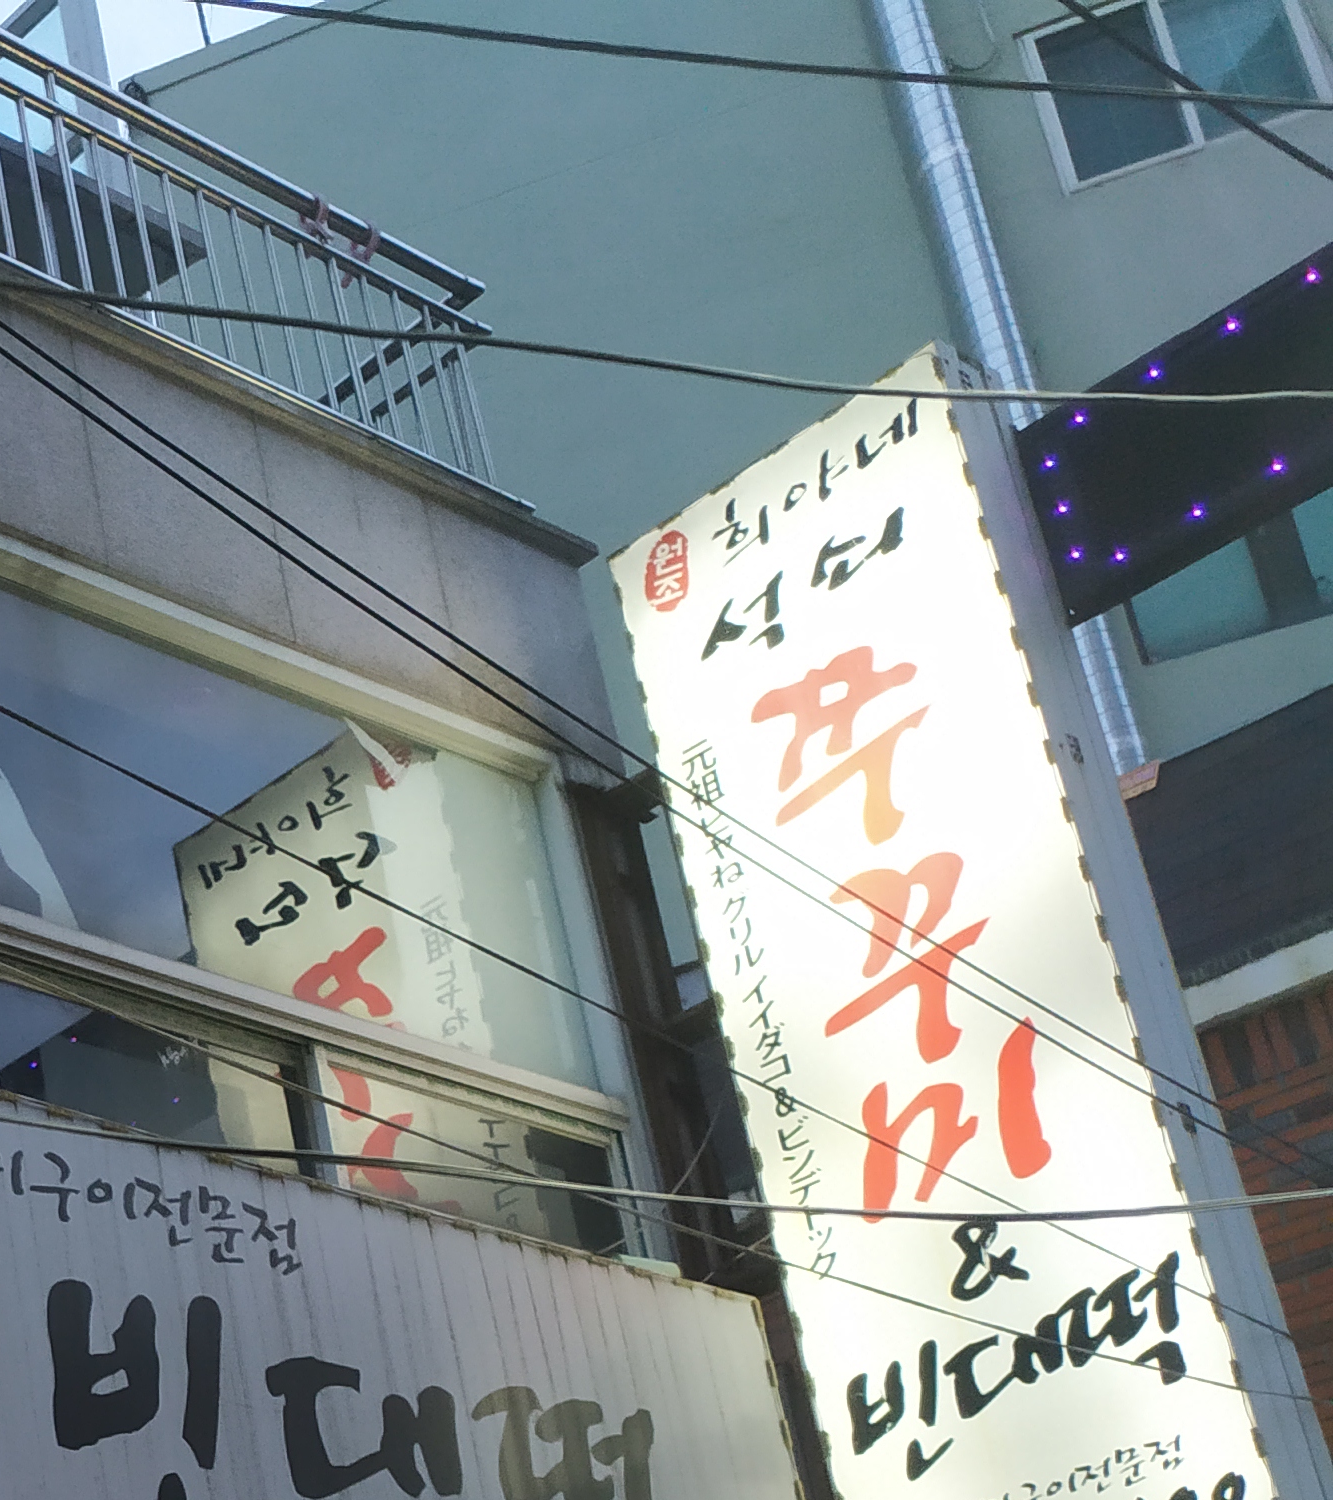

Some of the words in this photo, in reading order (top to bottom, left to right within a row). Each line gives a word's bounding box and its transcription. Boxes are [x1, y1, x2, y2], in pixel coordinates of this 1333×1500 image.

[710, 396, 920, 566] 희야네
[648, 534, 688, 608] 원조
[699, 506, 906, 661] 석쇠
[749, 645, 1053, 1224] 쭈꾸미
[949, 1218, 1031, 1301] &
[846, 1250, 1188, 1481] 빈대떡
